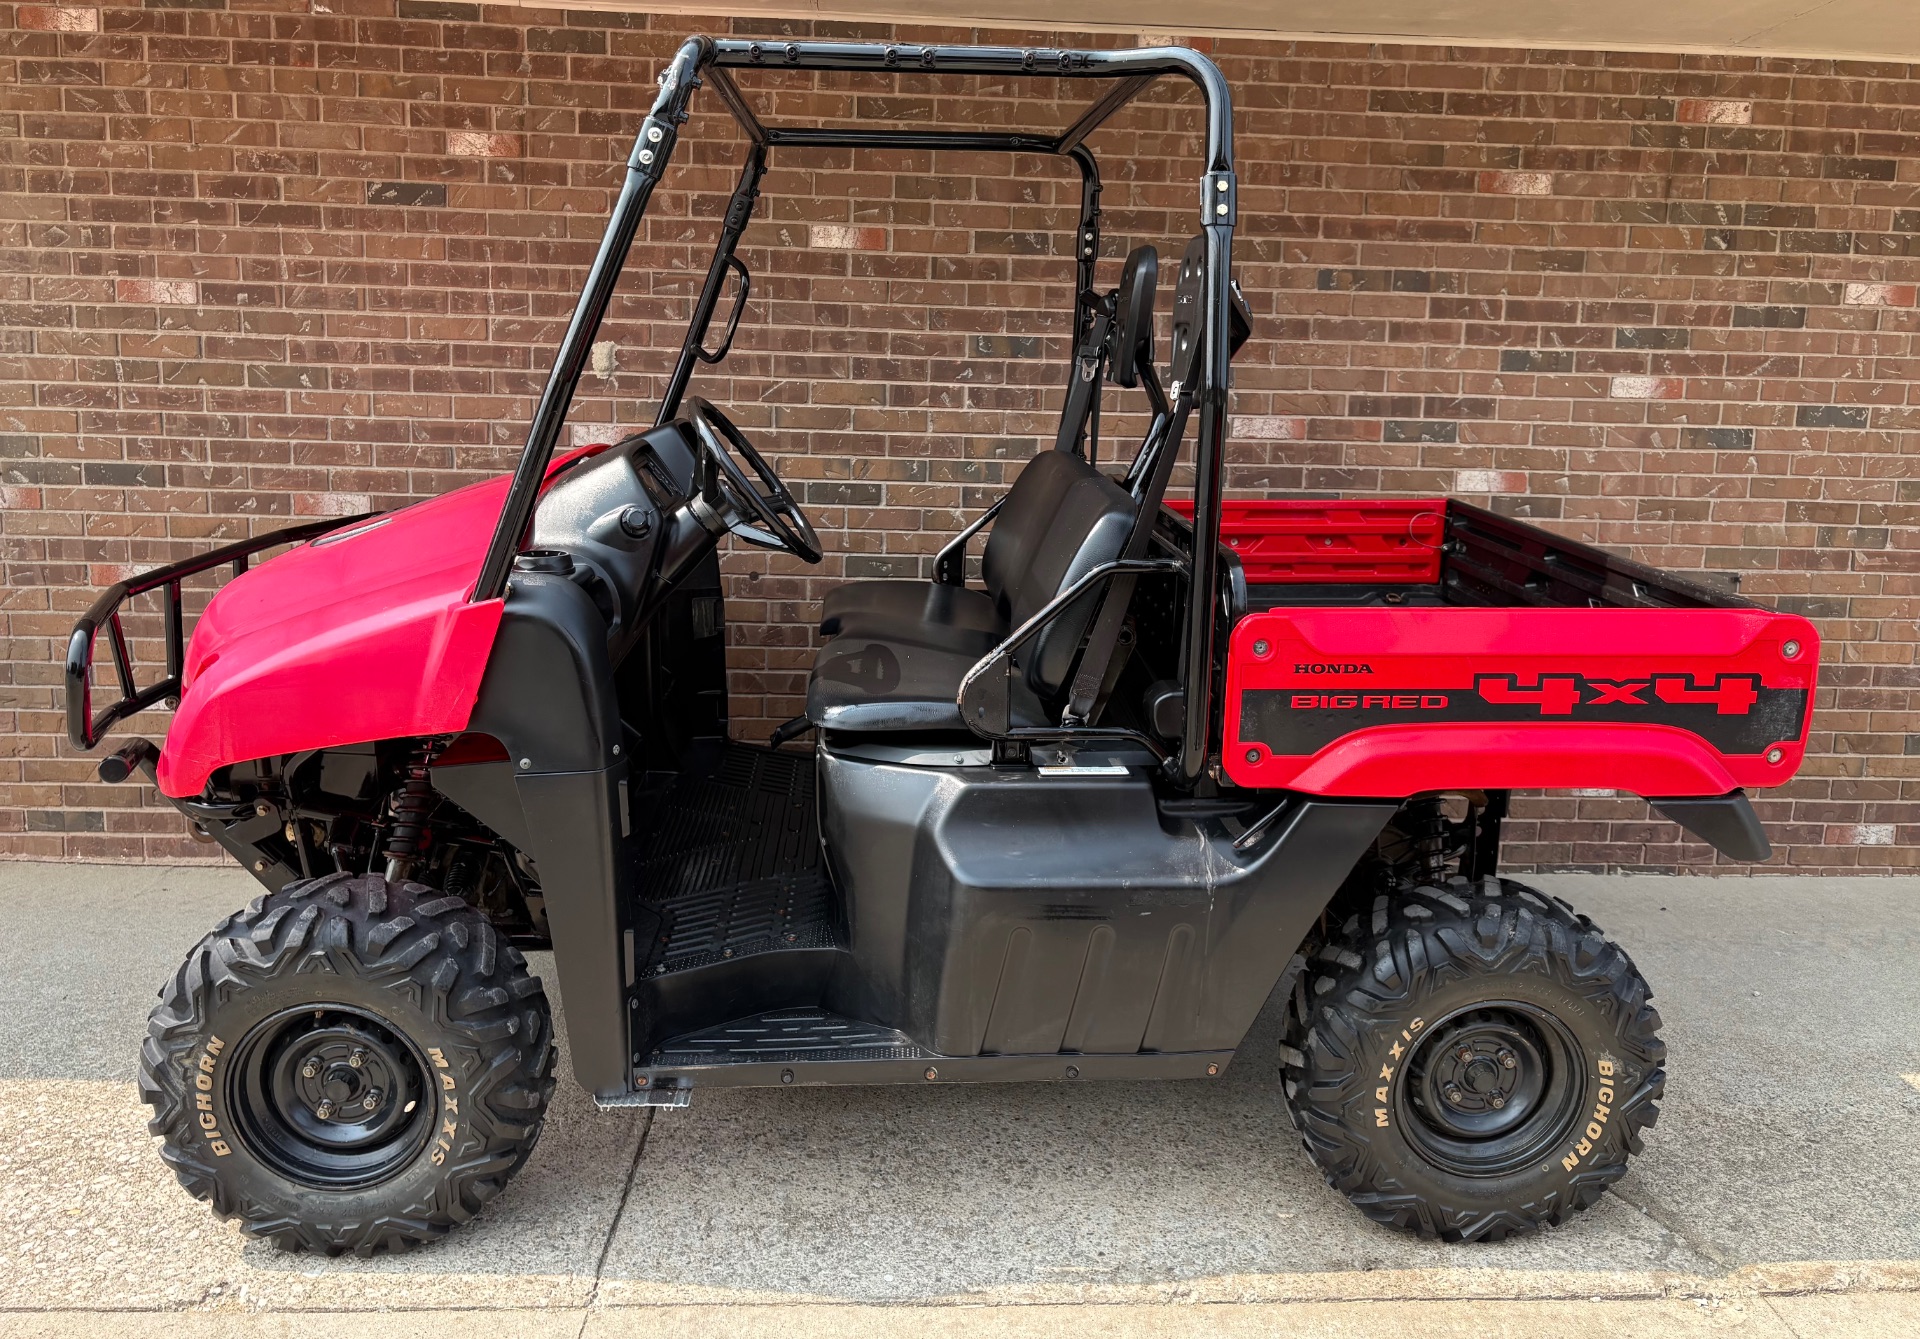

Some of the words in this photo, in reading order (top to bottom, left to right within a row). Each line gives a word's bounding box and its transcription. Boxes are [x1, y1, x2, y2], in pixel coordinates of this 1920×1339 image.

[1290, 695, 1358, 709] BIG
[1362, 695, 1449, 709] RED
[1294, 664, 1375, 674] HONDA
[195, 1035, 232, 1157] BIGHORN
[427, 1048, 460, 1167] MAXXIS
[1374, 1016, 1425, 1128] MAXXIS
[1561, 1058, 1616, 1173] BIGHORN
